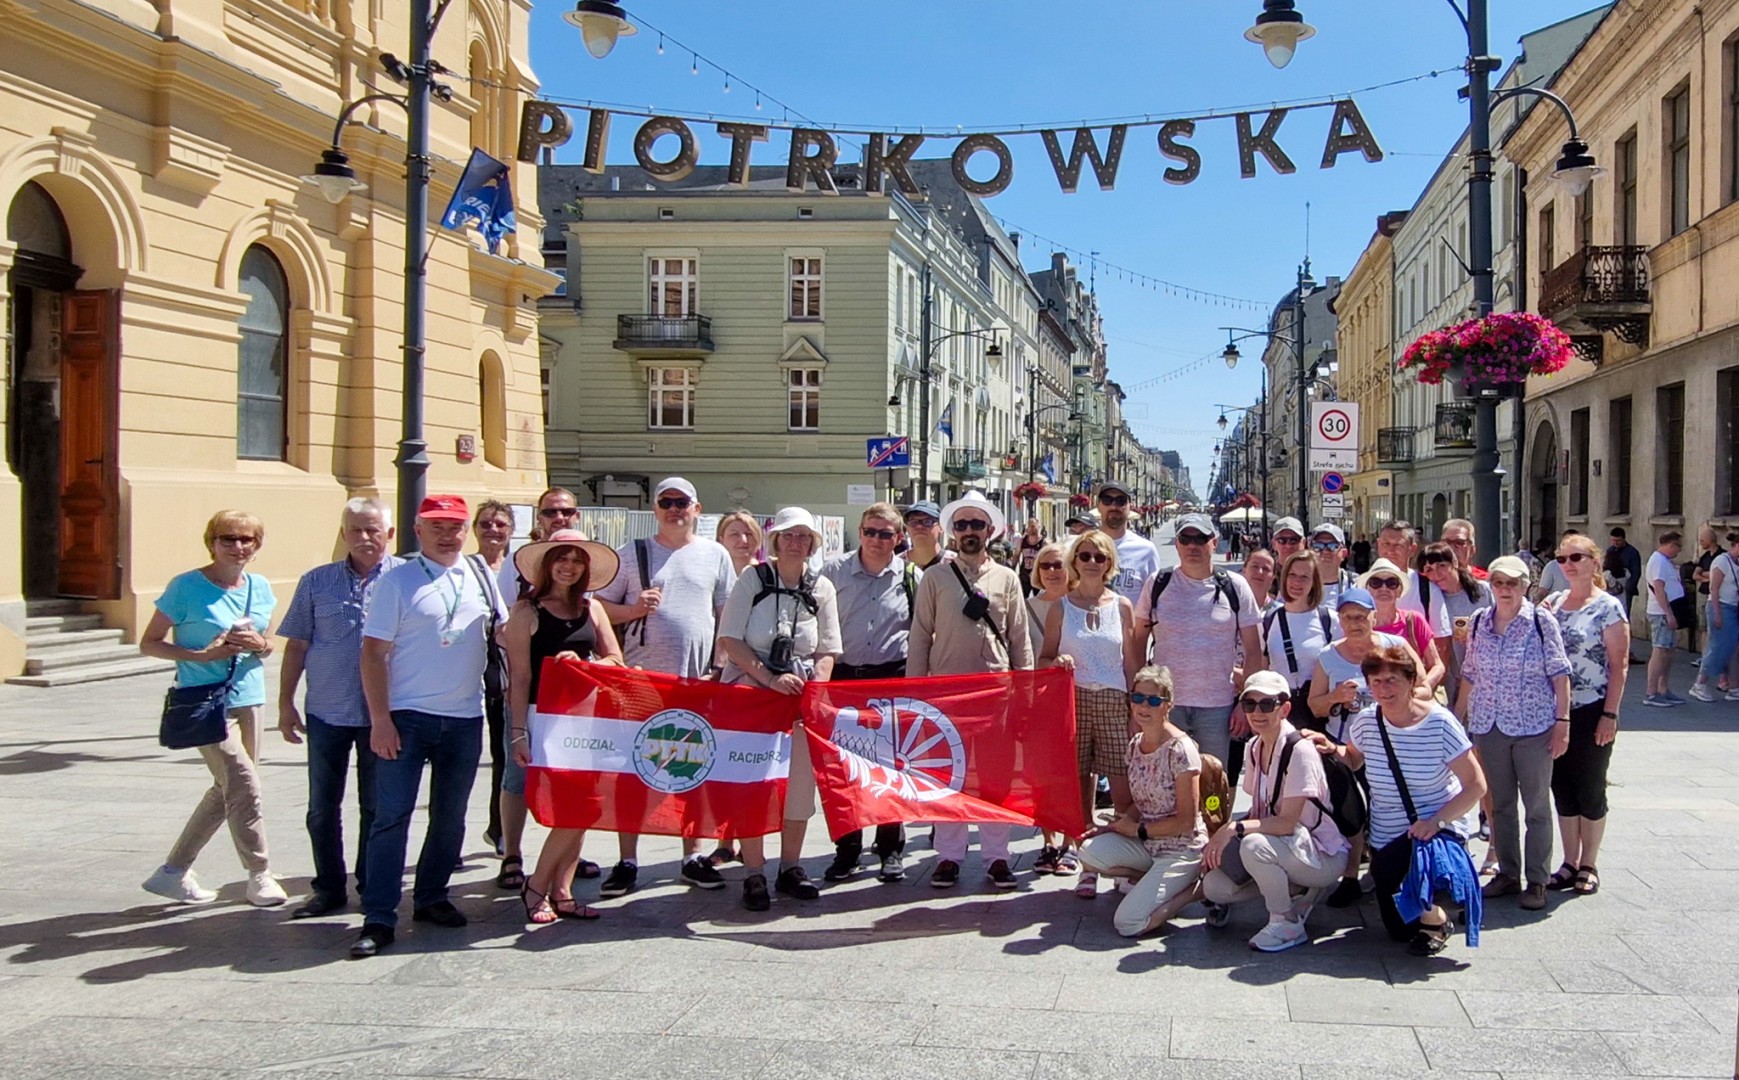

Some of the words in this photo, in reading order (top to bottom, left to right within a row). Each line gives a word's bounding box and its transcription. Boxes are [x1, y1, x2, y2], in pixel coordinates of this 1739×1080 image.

[517, 99, 1384, 198] PIOTRKOWSKA
[1324, 418, 1346, 432] 30
[563, 736, 616, 751] ODDZIAŁ
